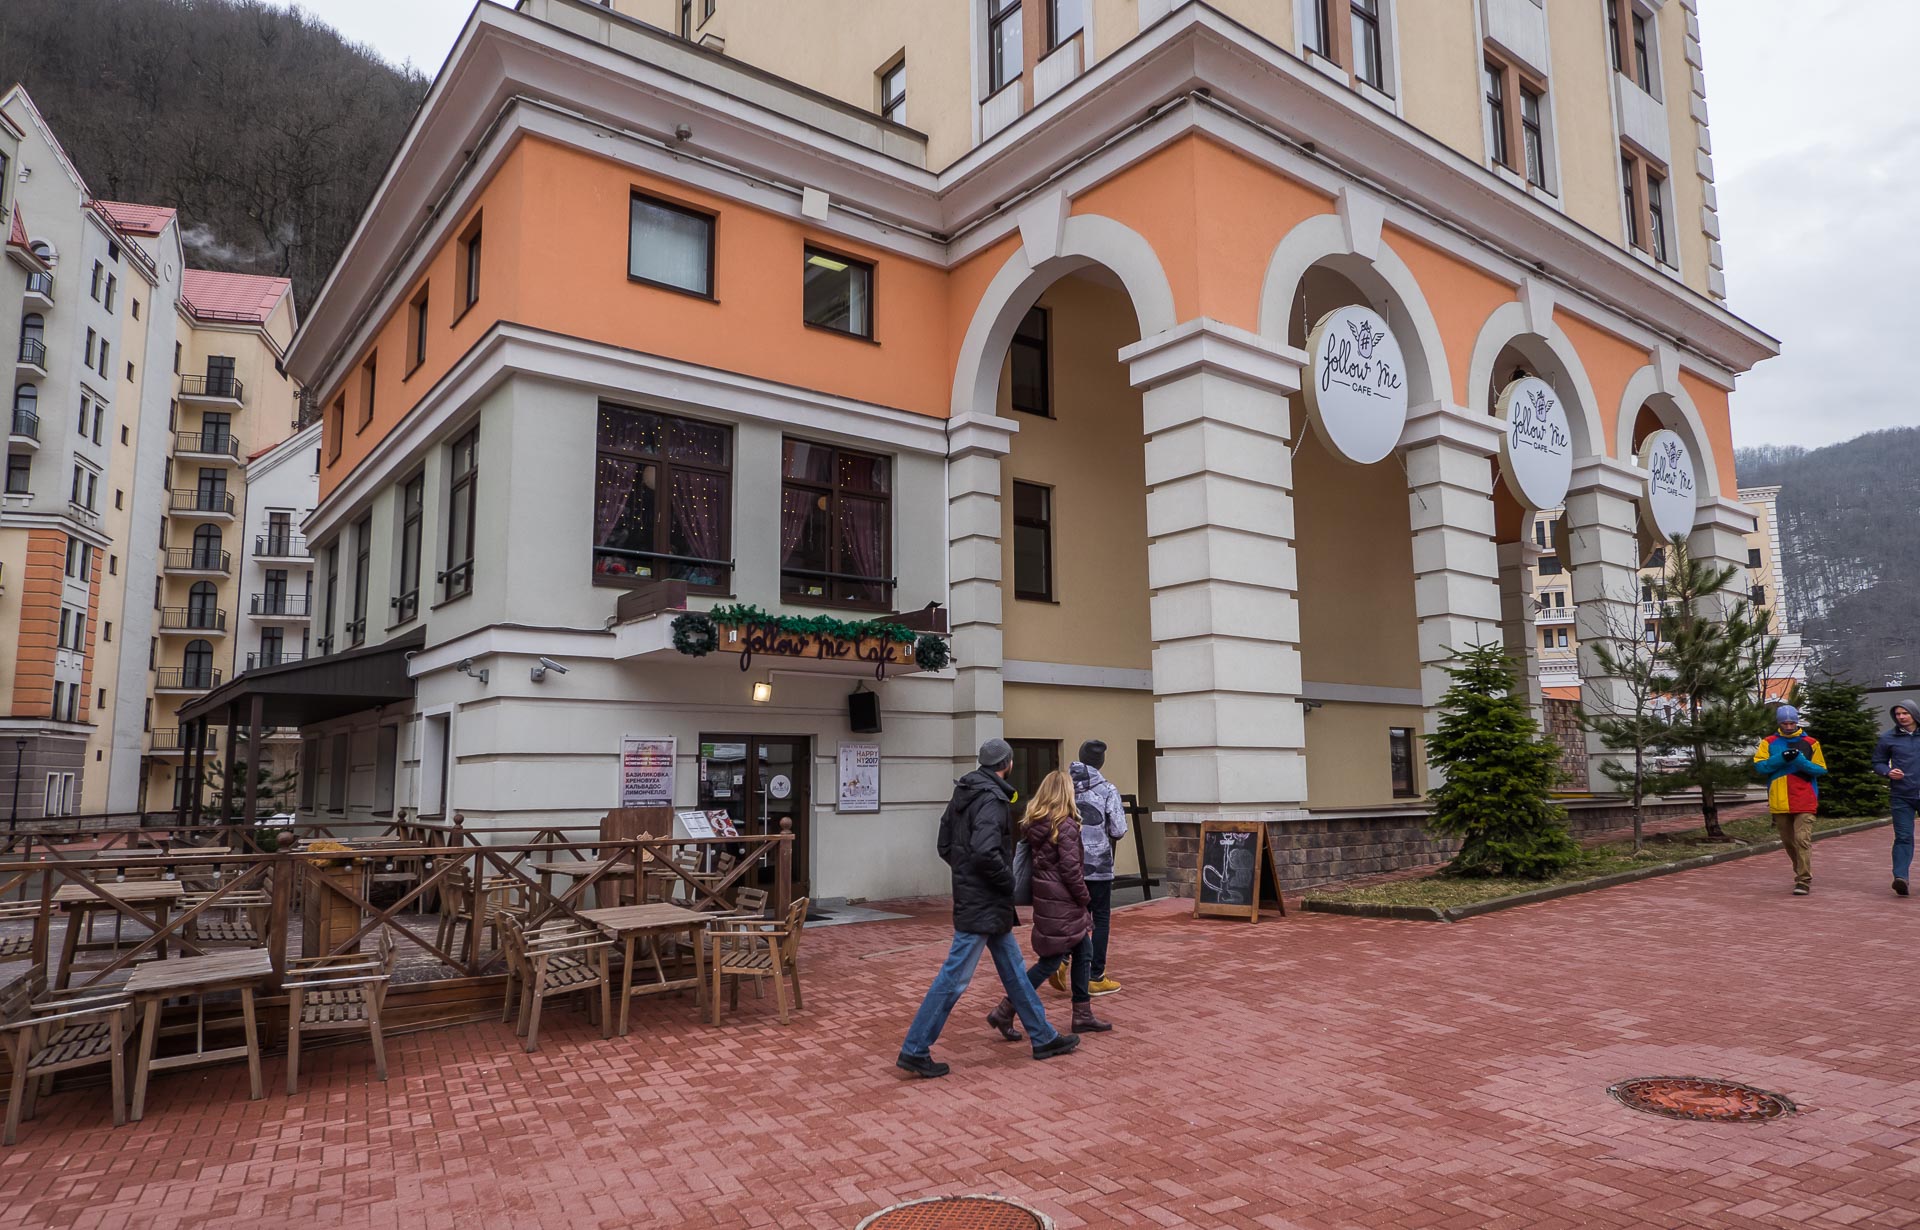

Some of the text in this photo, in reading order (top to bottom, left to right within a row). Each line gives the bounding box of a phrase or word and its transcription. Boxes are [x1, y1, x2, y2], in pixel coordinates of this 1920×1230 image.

[1322, 333, 1371, 392] follow
[1351, 382, 1372, 396] CAFE
[1512, 401, 1546, 450] follow
[1533, 442, 1548, 453] CAFE
[1651, 452, 1677, 496] follow
[1667, 487, 1678, 497] CAFE
[739, 622, 810, 672] follow
